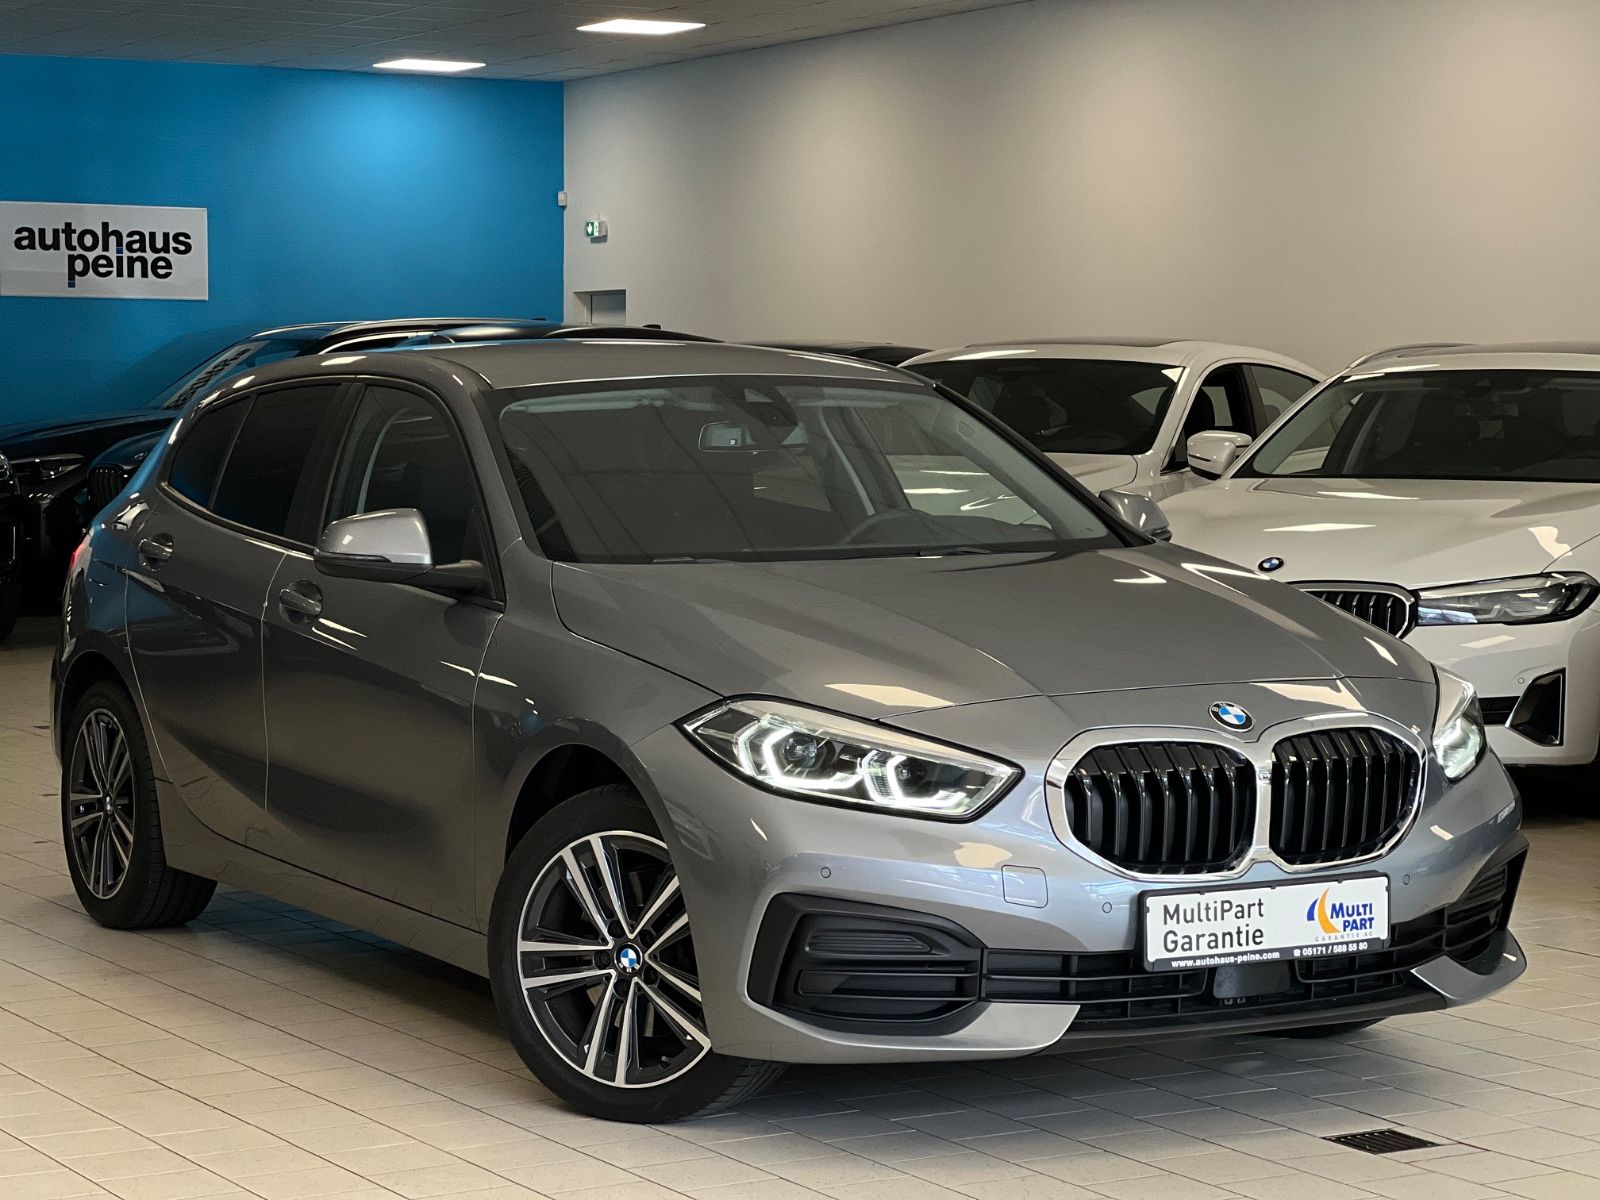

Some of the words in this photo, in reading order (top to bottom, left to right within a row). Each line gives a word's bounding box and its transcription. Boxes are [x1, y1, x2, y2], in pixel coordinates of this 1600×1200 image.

[14, 221, 192, 255] autohaus
[68, 247, 173, 288] peine
[1163, 898, 1264, 925] MultiPart
[1330, 902, 1373, 920] MULTI
[1342, 917, 1375, 932] PART
[1163, 924, 1264, 953] Garantie
[1171, 951, 1280, 968] www.autohaus-peine.com
[1302, 946, 1326, 956] 05171
